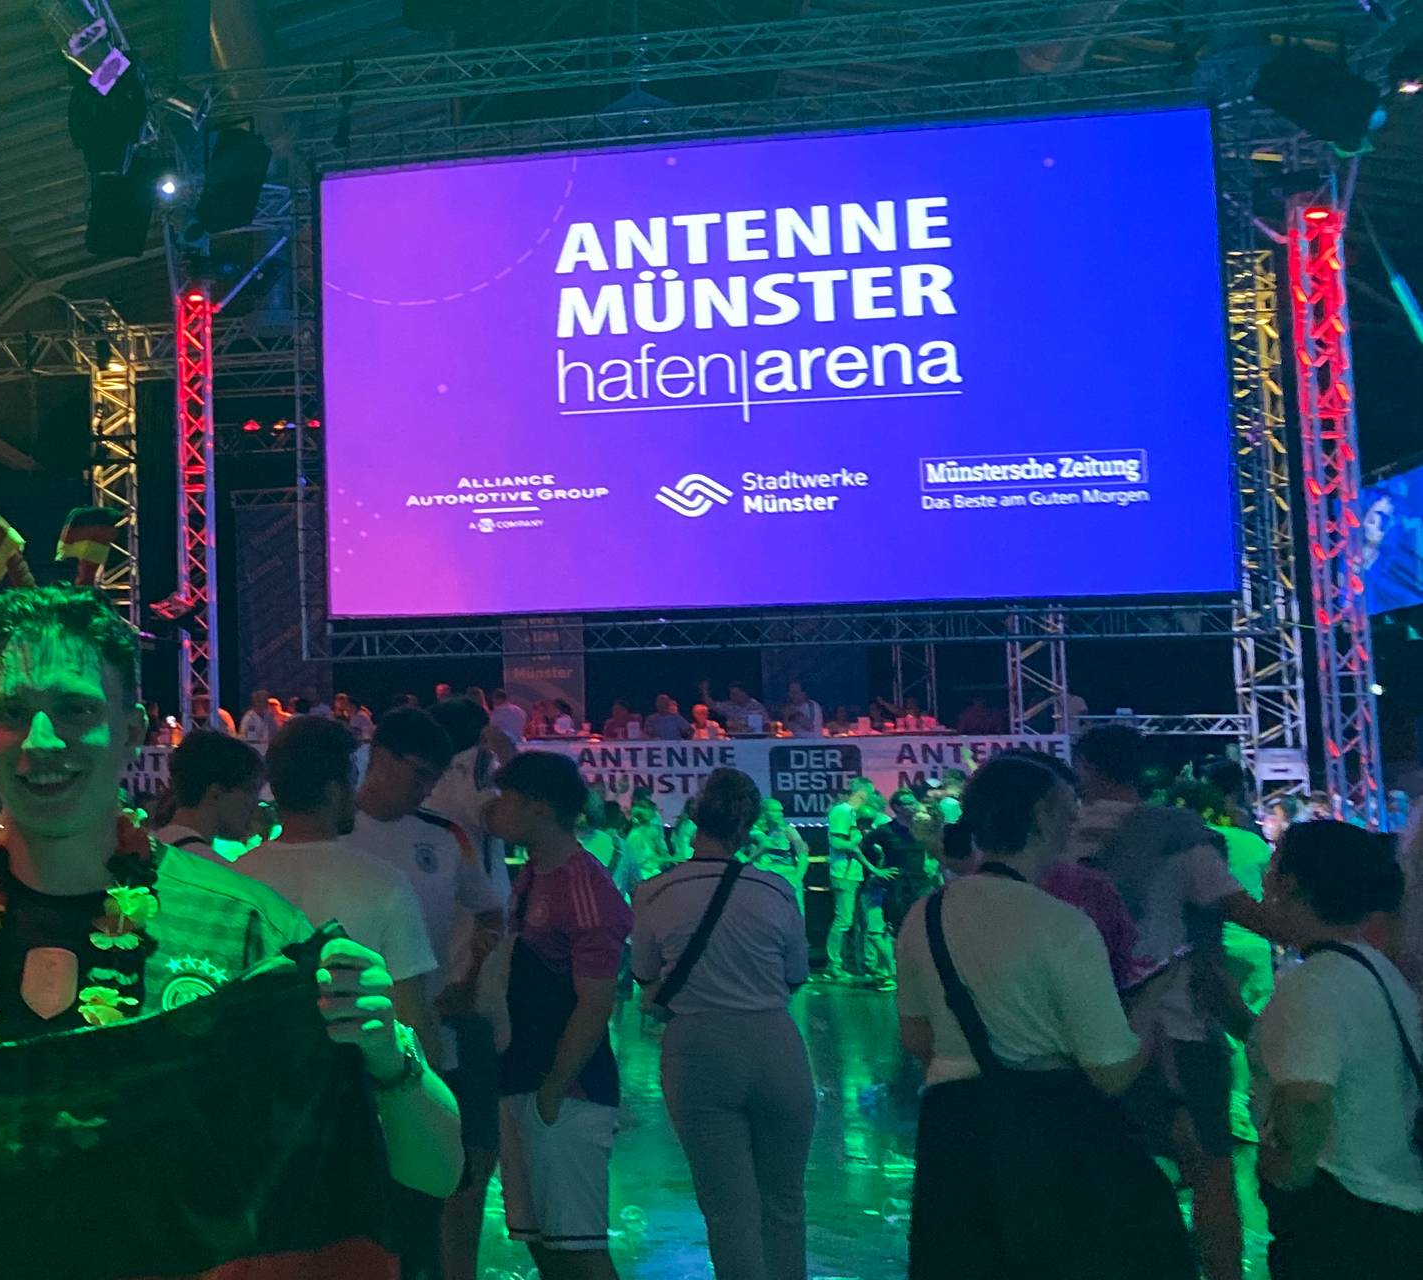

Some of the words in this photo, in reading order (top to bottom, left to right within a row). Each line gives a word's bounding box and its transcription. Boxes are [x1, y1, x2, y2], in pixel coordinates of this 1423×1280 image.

[555, 196, 952, 274] ANTENNE
[556, 263, 957, 338] MÜNSTER
[741, 467, 869, 491] Stadtwerke
[925, 457, 1056, 483] Münstersche
[1058, 455, 1140, 482] Zeitung
[537, 487, 609, 501] GROUP
[743, 494, 839, 513] Münster
[921, 495, 951, 510] Das
[953, 494, 996, 508] Beste
[1000, 494, 1026, 507] am
[1028, 491, 1079, 506] Guten
[1081, 489, 1150, 506] Morgen
[578, 746, 736, 767] ANTENNE
[790, 749, 843, 769] DER
[776, 771, 857, 791] BESTE
